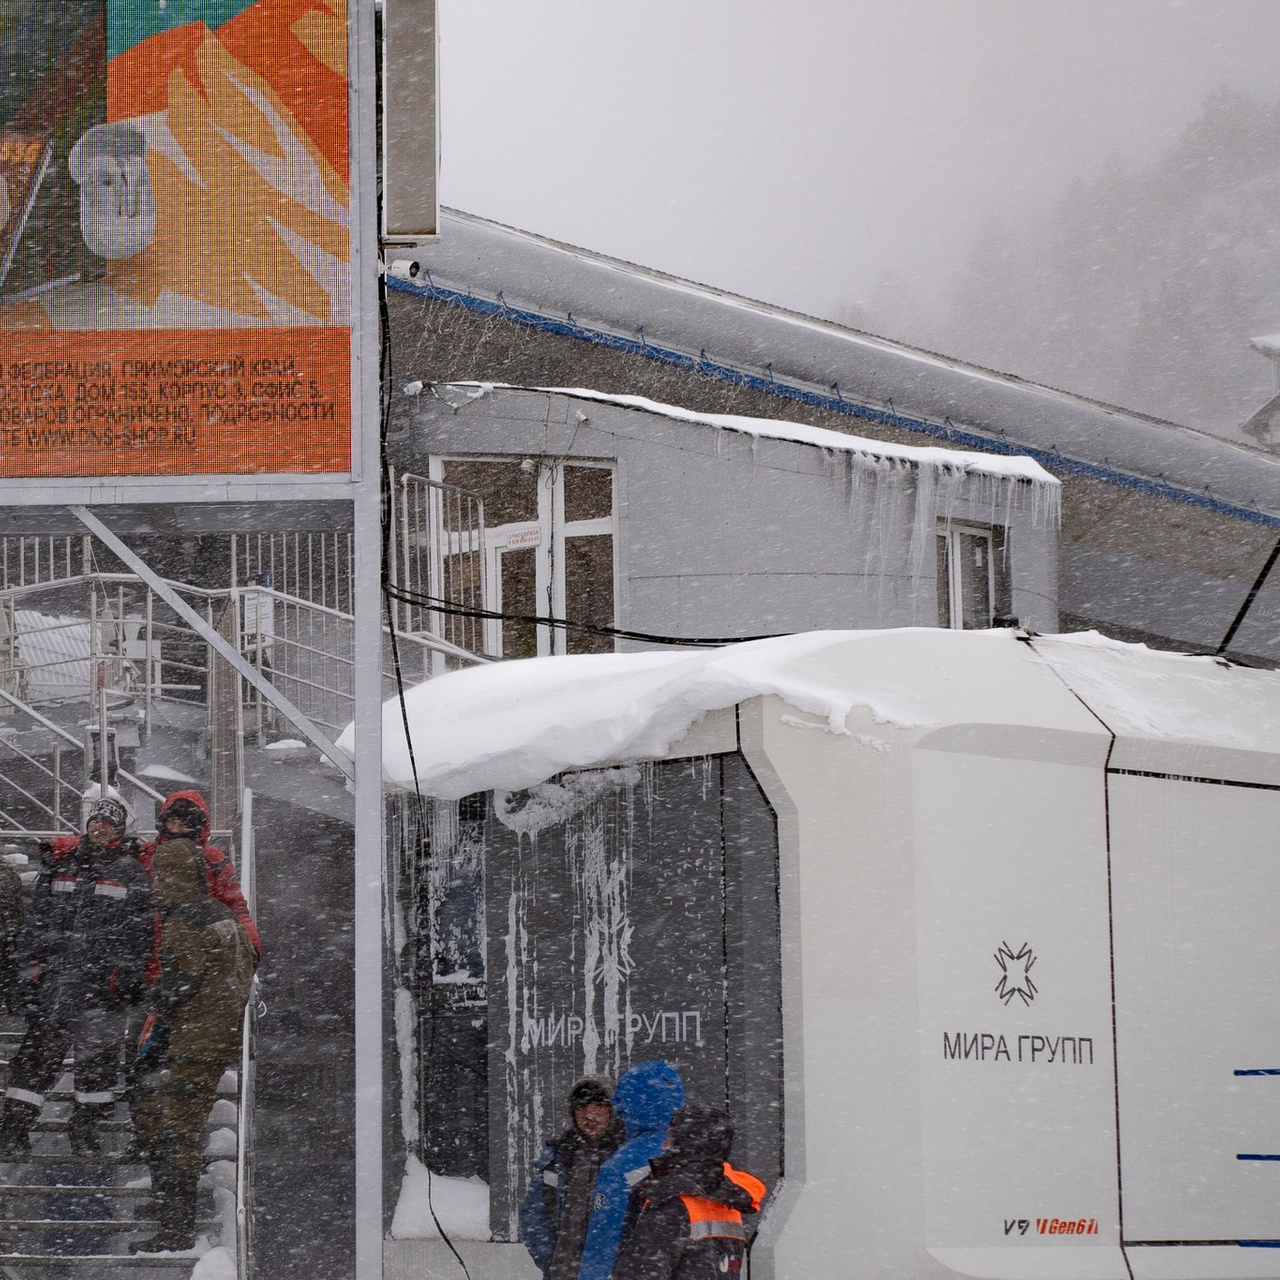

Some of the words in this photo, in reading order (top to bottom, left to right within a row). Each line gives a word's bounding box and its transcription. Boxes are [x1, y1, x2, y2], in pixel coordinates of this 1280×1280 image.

[122, 355, 246, 377] ПРИМОРСКИЙ
[76, 382, 115, 403] ДОМ
[158, 381, 227, 401] КОРПУС
[251, 380, 303, 400] ОФИС
[201, 401, 336, 424] ПОДРОБНОСТИ
[943, 1032, 1011, 1062] МИРА
[1018, 1034, 1093, 1065] ГРУПП
[1004, 1219, 1030, 1235] V9
